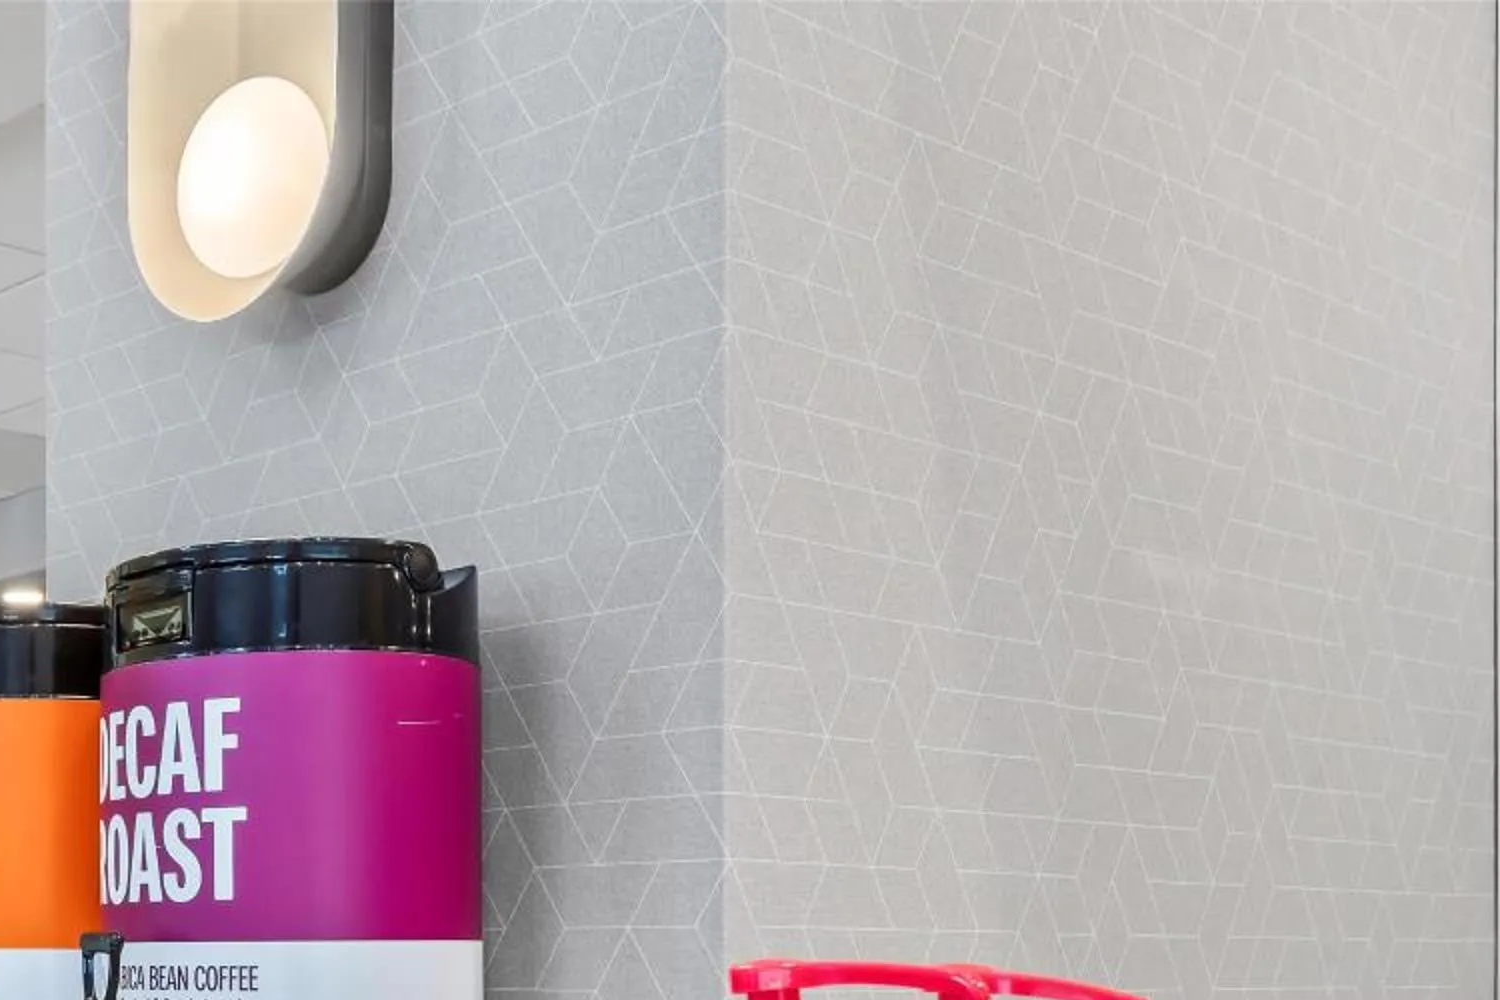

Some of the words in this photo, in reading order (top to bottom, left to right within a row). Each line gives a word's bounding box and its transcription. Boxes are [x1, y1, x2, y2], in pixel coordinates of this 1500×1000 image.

[121, 965, 145, 990] BICA
[149, 965, 189, 990] BEAN
[194, 965, 259, 991] COFFEE
